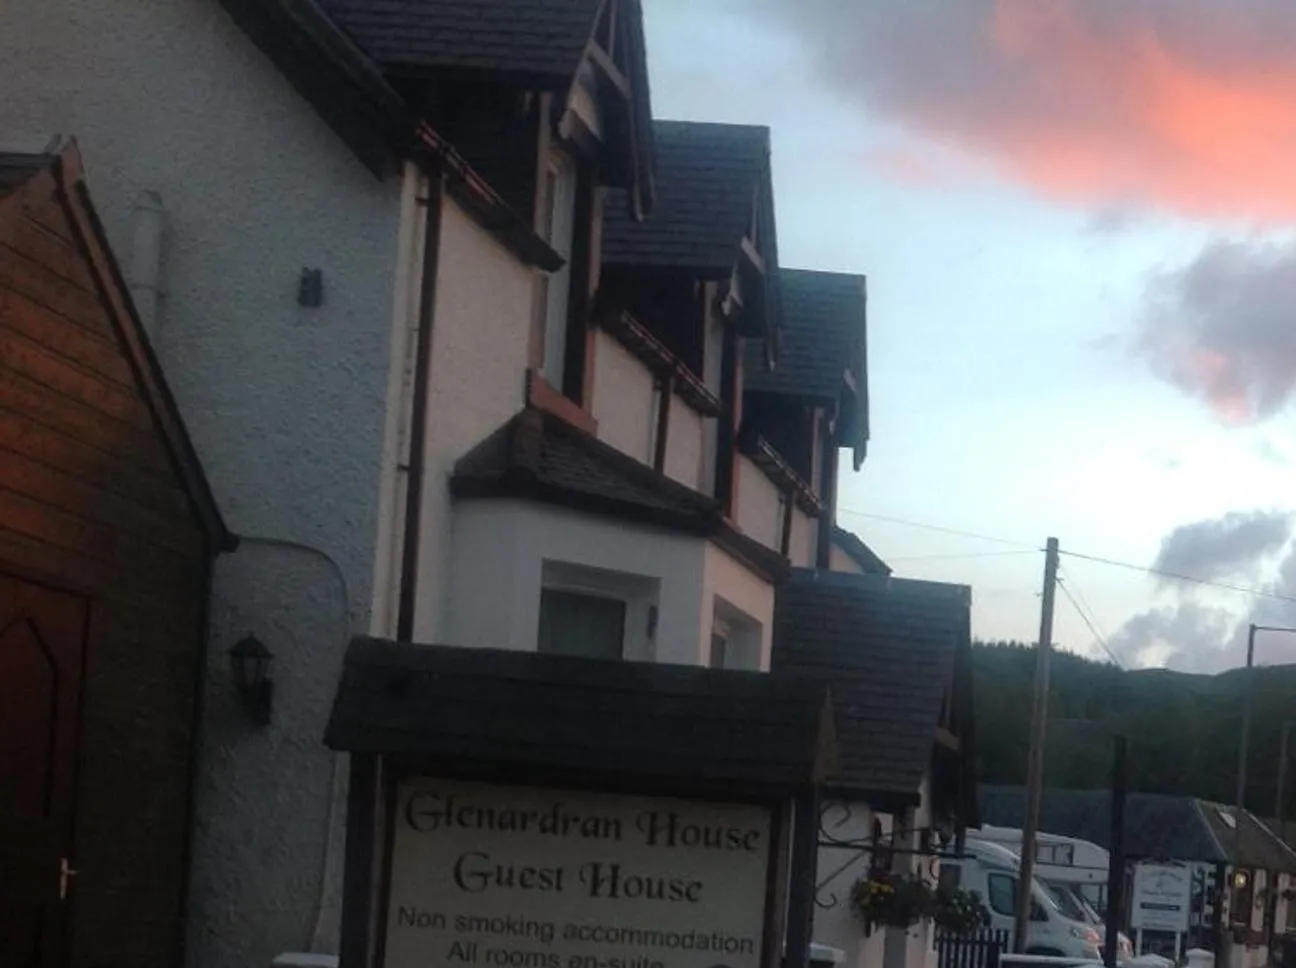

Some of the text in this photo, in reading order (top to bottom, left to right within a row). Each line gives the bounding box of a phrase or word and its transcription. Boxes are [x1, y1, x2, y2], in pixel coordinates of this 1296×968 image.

[403, 789, 761, 851] Glenardran House
[453, 851, 704, 903] Guest House
[398, 906, 754, 954] Non smoking accommodation
[447, 941, 477, 963] All
[486, 948, 560, 968] rooms
